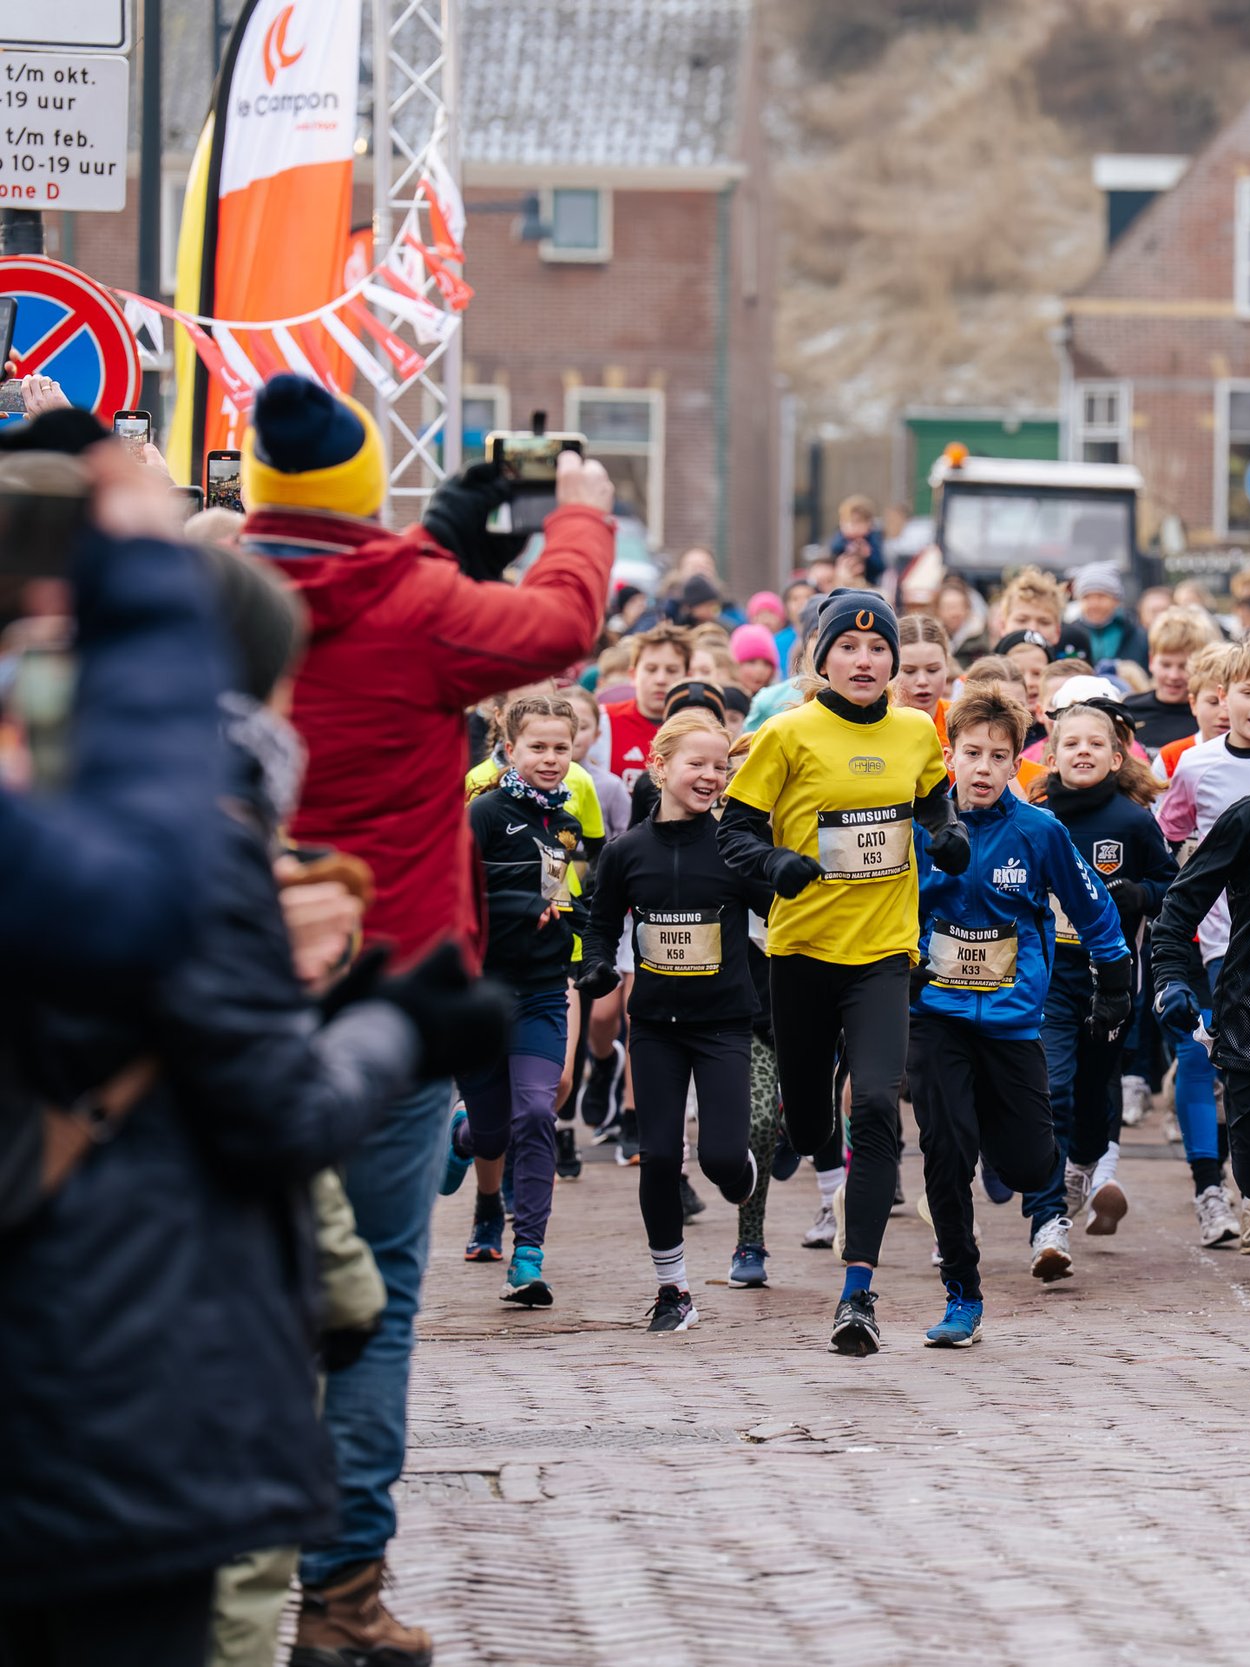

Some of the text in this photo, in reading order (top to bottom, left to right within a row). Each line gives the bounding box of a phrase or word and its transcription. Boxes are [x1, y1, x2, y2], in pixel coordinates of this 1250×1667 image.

[6, 64, 95, 85] t/m okt.
[38, 96, 76, 110] uur
[6, 127, 94, 148] t/m feb.
[12, 154, 70, 173] 10-19
[80, 161, 116, 175] uur
[47, 183, 60, 200] D
[841, 808, 897, 824] SAMSUNG
[857, 831, 886, 848] CATO
[863, 851, 882, 865] K53
[851, 870, 871, 879] HALVE
[649, 913, 702, 923] SAMSUNG
[660, 931, 691, 944] RIVER
[949, 925, 999, 940] SAMSUNG
[667, 948, 685, 960] K58
[957, 946, 986, 962] KOEN
[962, 965, 980, 975] K33
